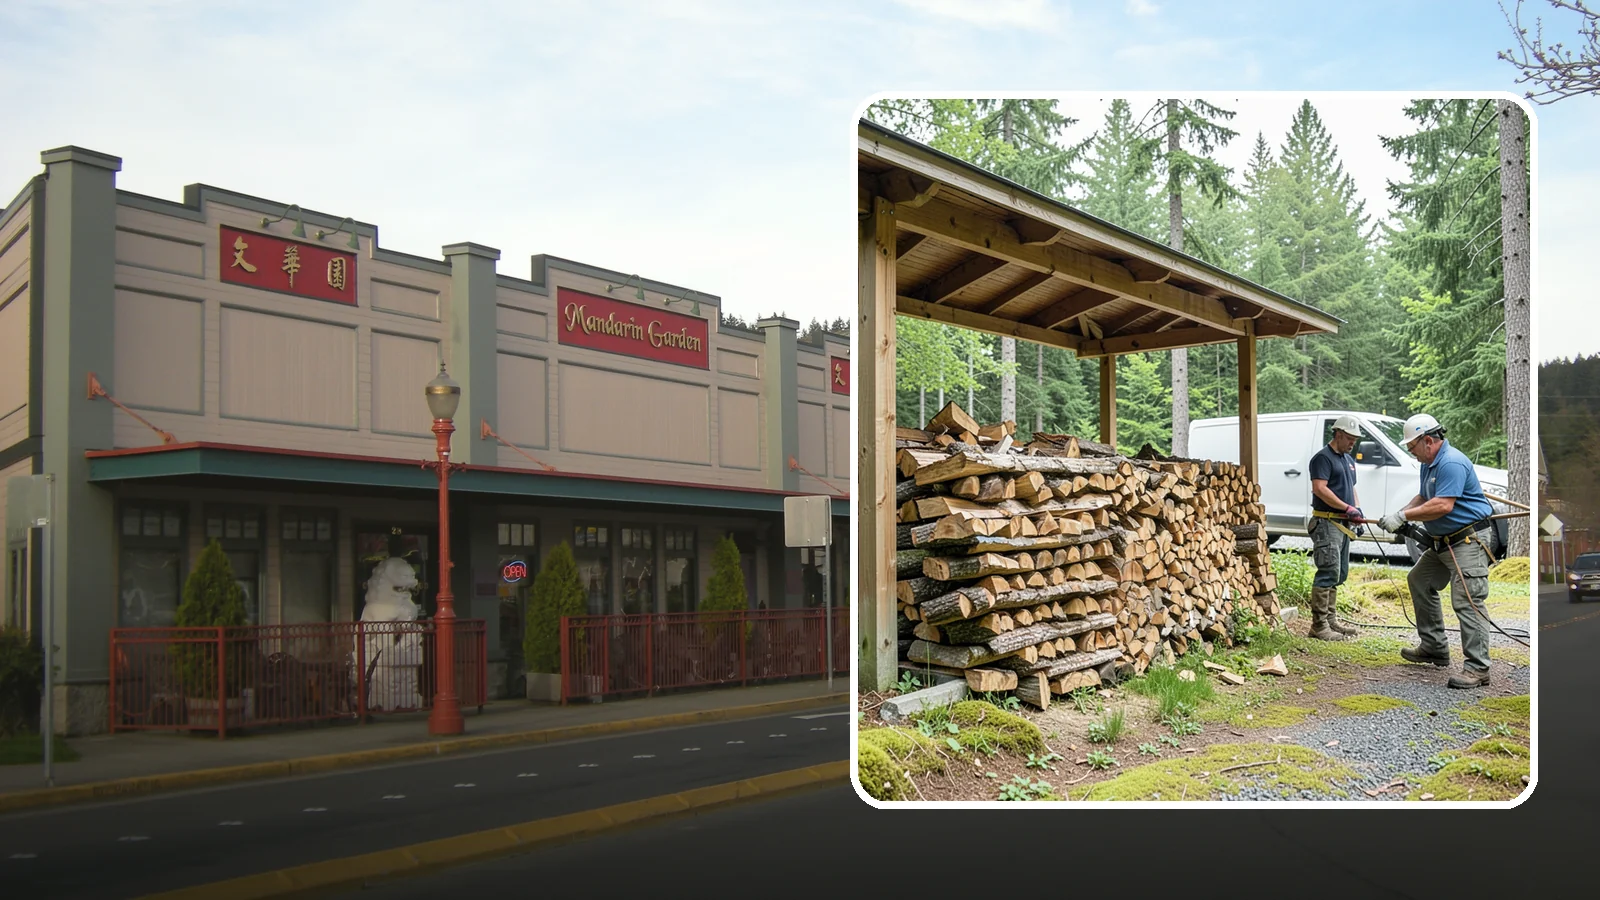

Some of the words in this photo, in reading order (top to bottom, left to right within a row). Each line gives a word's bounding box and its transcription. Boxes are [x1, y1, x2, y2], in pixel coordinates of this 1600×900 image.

[230, 235, 346, 291] 文華園
[564, 302, 644, 341] Mandarin
[647, 320, 701, 352] Garden
[503, 565, 527, 578] OPEN
